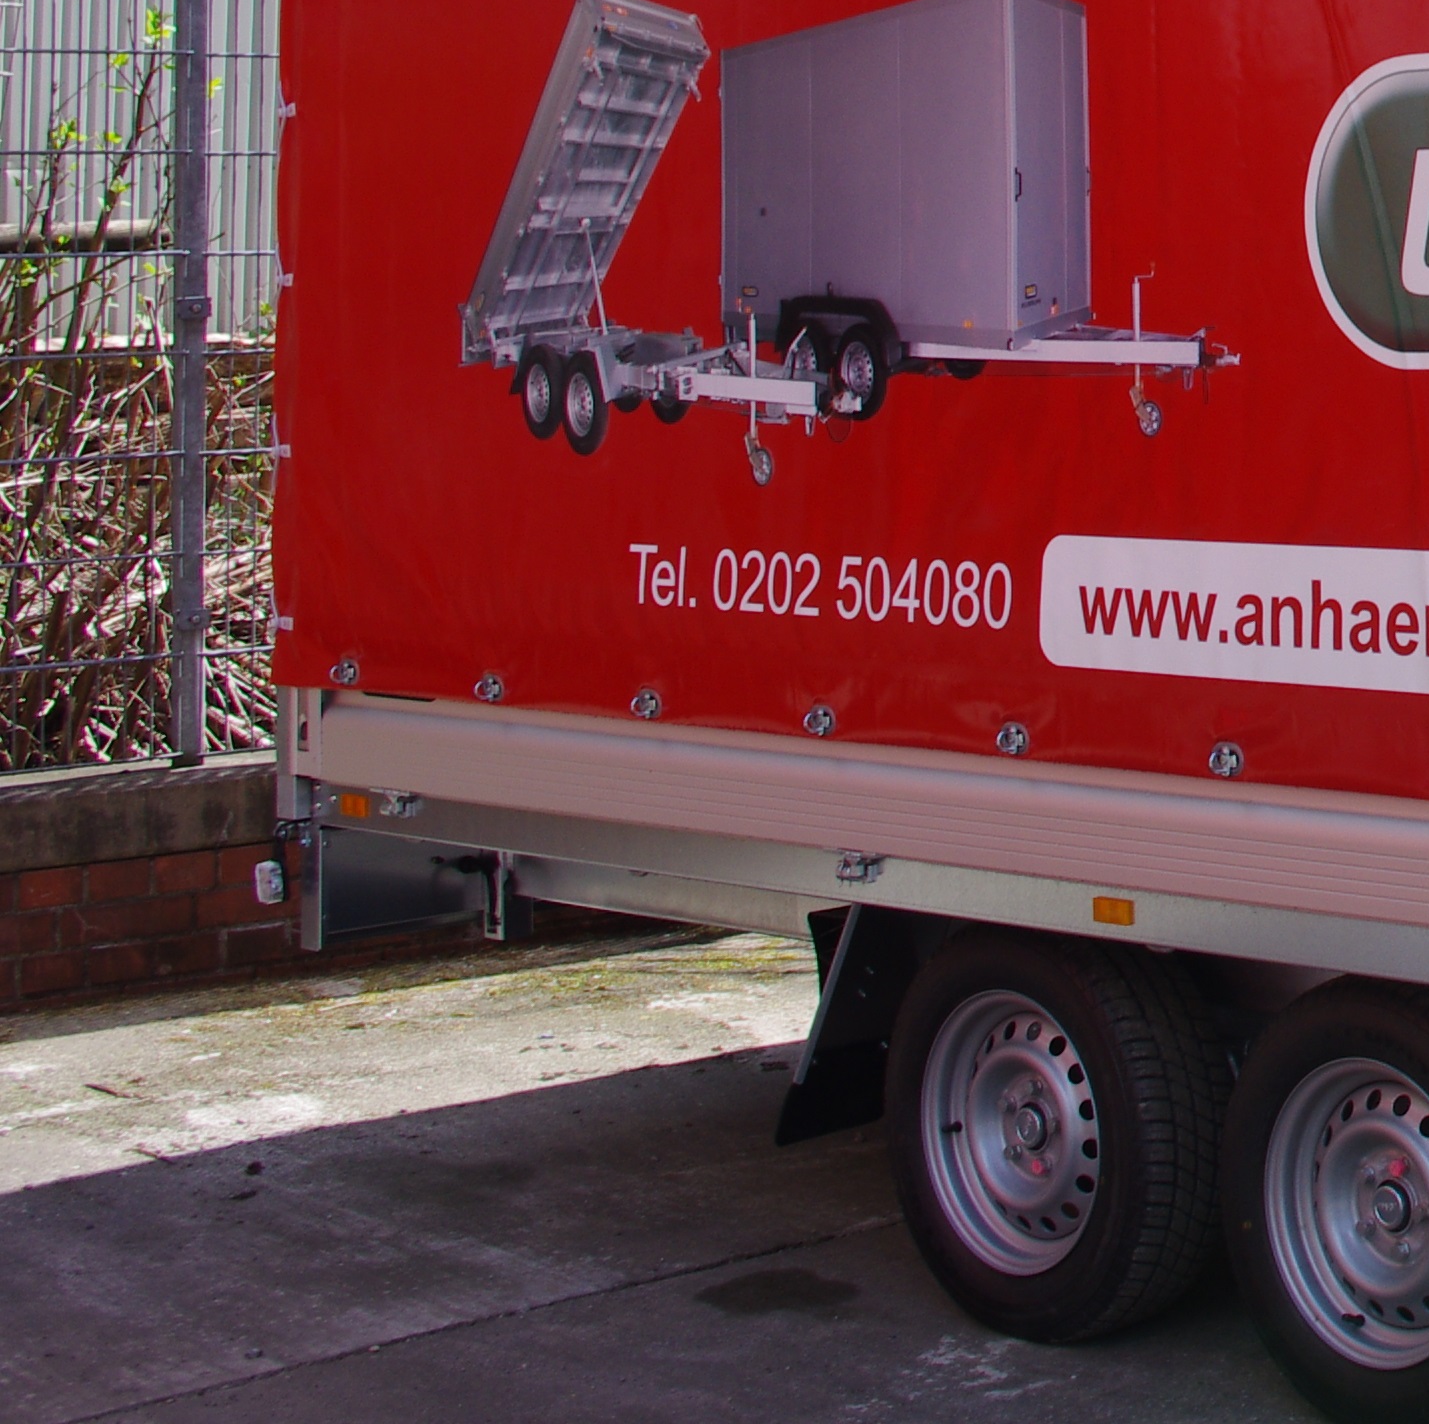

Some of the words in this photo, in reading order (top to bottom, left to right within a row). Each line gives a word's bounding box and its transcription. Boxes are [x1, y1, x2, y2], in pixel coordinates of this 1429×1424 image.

[630, 544, 696, 607] Tel.
[714, 549, 820, 616] 0202
[837, 557, 1012, 630] 504080
